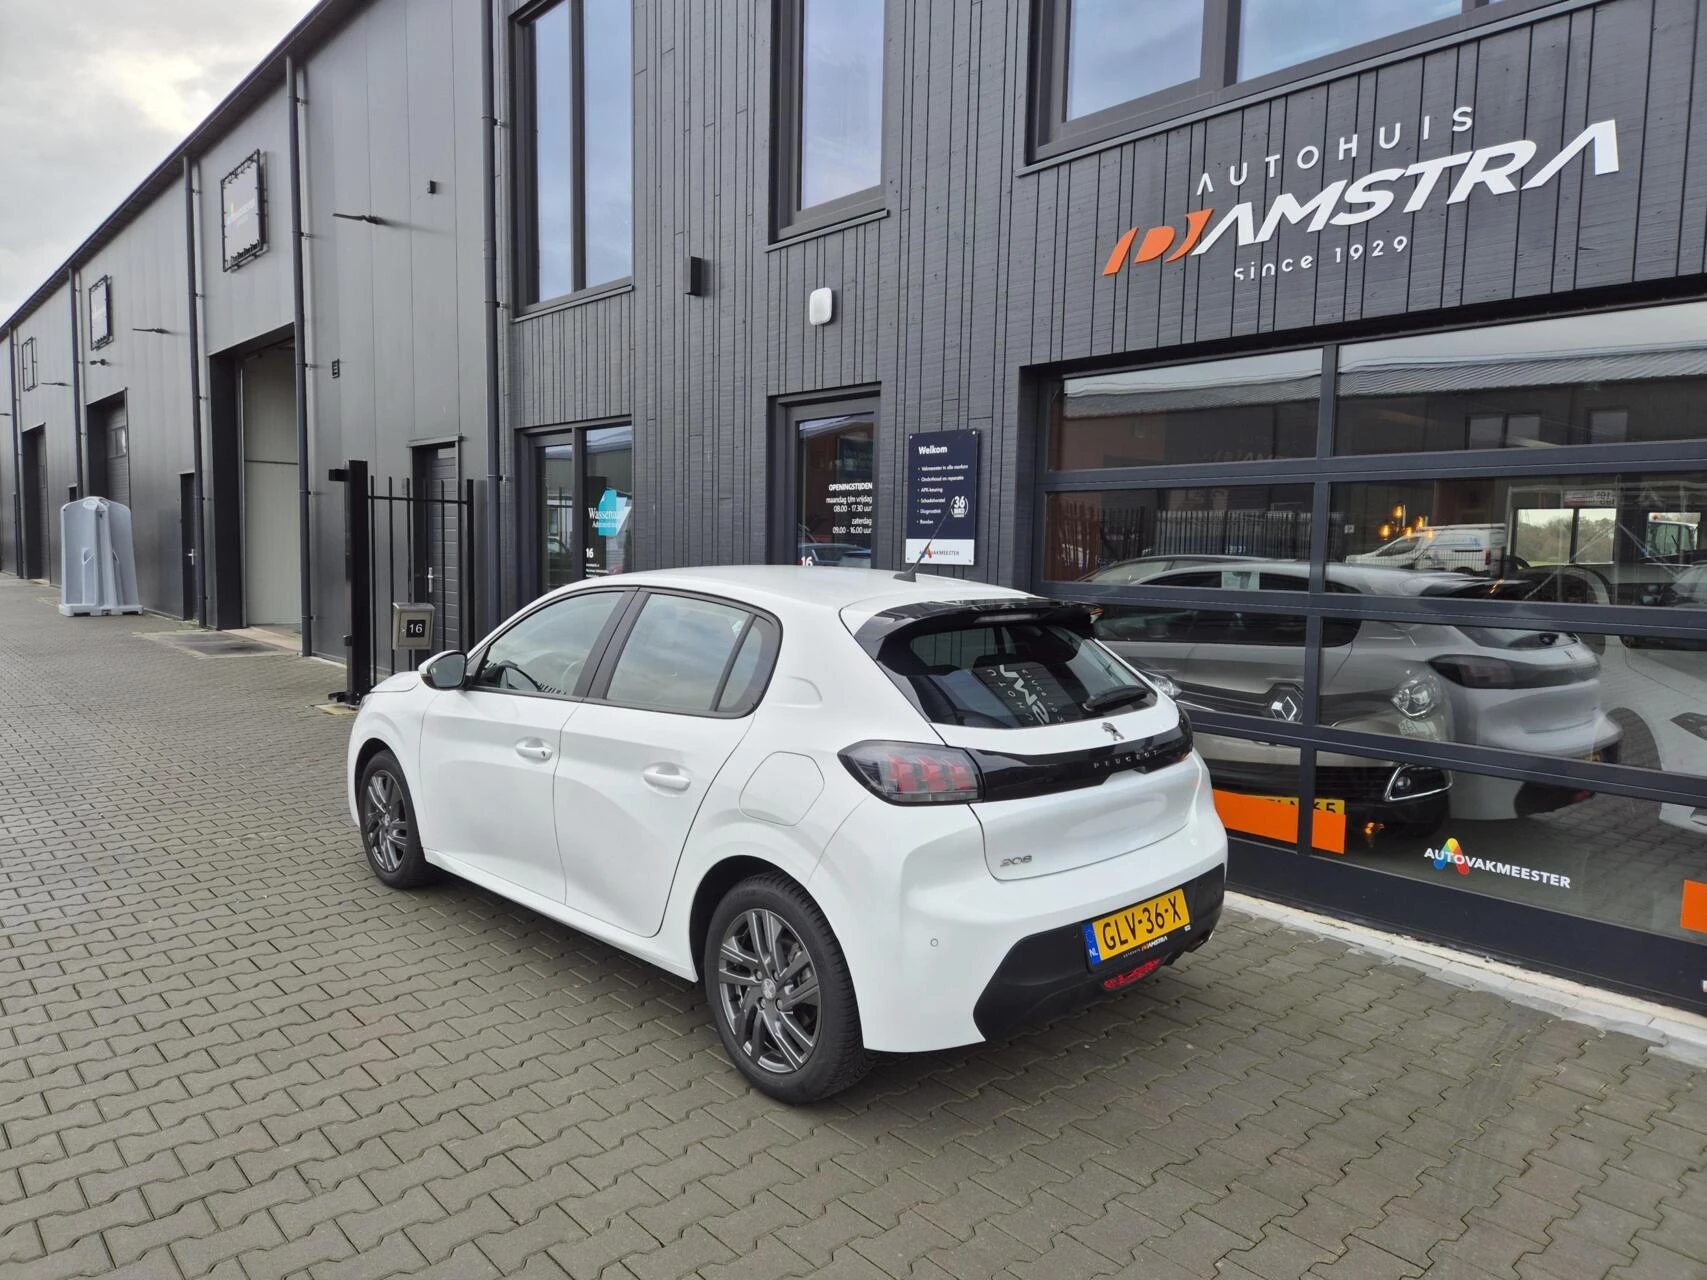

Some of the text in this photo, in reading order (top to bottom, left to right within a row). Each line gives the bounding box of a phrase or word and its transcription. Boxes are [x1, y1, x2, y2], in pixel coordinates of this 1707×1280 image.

[1197, 106, 1473, 195] AUTOHUIS
[1234, 236, 1408, 280] since 1929
[918, 445, 948, 455] Welkom
[828, 482, 872, 491] OPENINGSTIJDEN
[954, 496, 966, 508] 36
[852, 517, 872, 526] zaterdag
[585, 547, 594, 558] 16
[801, 556, 813, 566] 16
[408, 623, 423, 634] 16
[1093, 751, 1159, 769] PEUGEOT
[1000, 855, 1032, 867] 208
[1424, 847, 1571, 889] AUTOVAKMEESTER
[1102, 895, 1182, 951] GLV-36-X
[1089, 948, 1099, 957] NL
